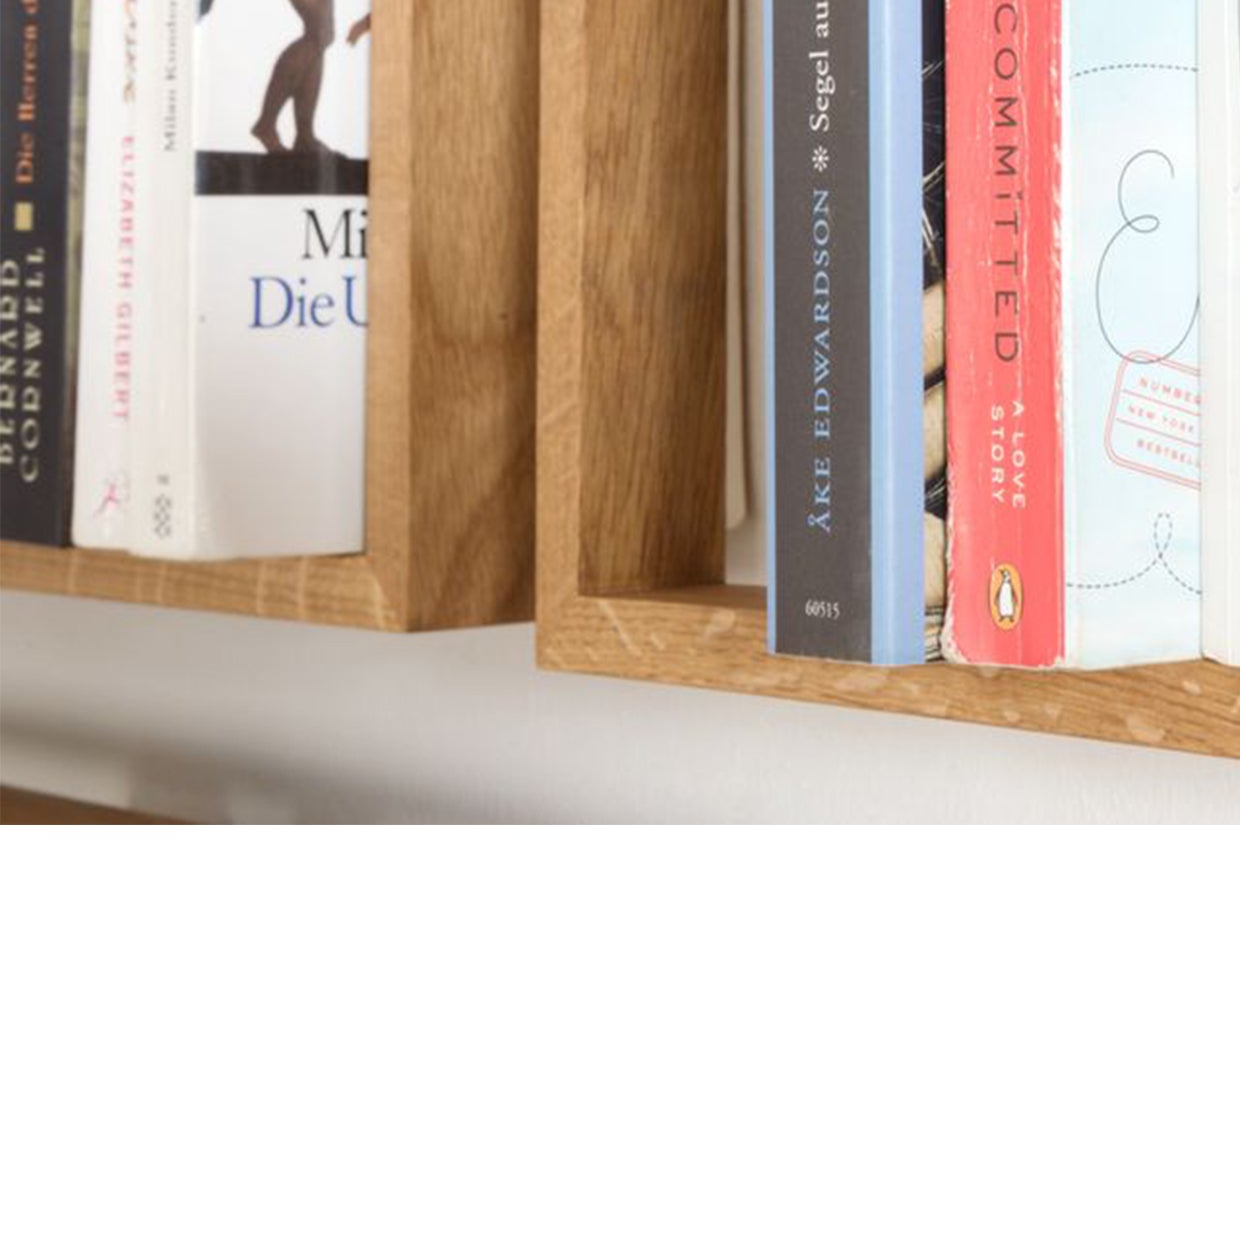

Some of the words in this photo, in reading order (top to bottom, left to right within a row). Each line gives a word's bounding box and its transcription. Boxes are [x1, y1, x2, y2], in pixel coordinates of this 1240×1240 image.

[17, 22, 39, 121] Herren
[809, 49, 836, 133] Segel
[15, 132, 35, 185] Die
[994, 2, 1020, 363] COMMITTED
[117, 135, 136, 290] ELIZABETH
[248, 275, 336, 330] Die
[813, 190, 832, 440] EDWARDSON
[20, 246, 46, 484] CORNWELL
[113, 301, 133, 423] GILBERT
[1011, 400, 1025, 417] A
[806, 456, 832, 534] ÅKE
[990, 405, 1005, 505] STORY
[1011, 431, 1027, 510] LOVE
[805, 600, 841, 620] 60515
